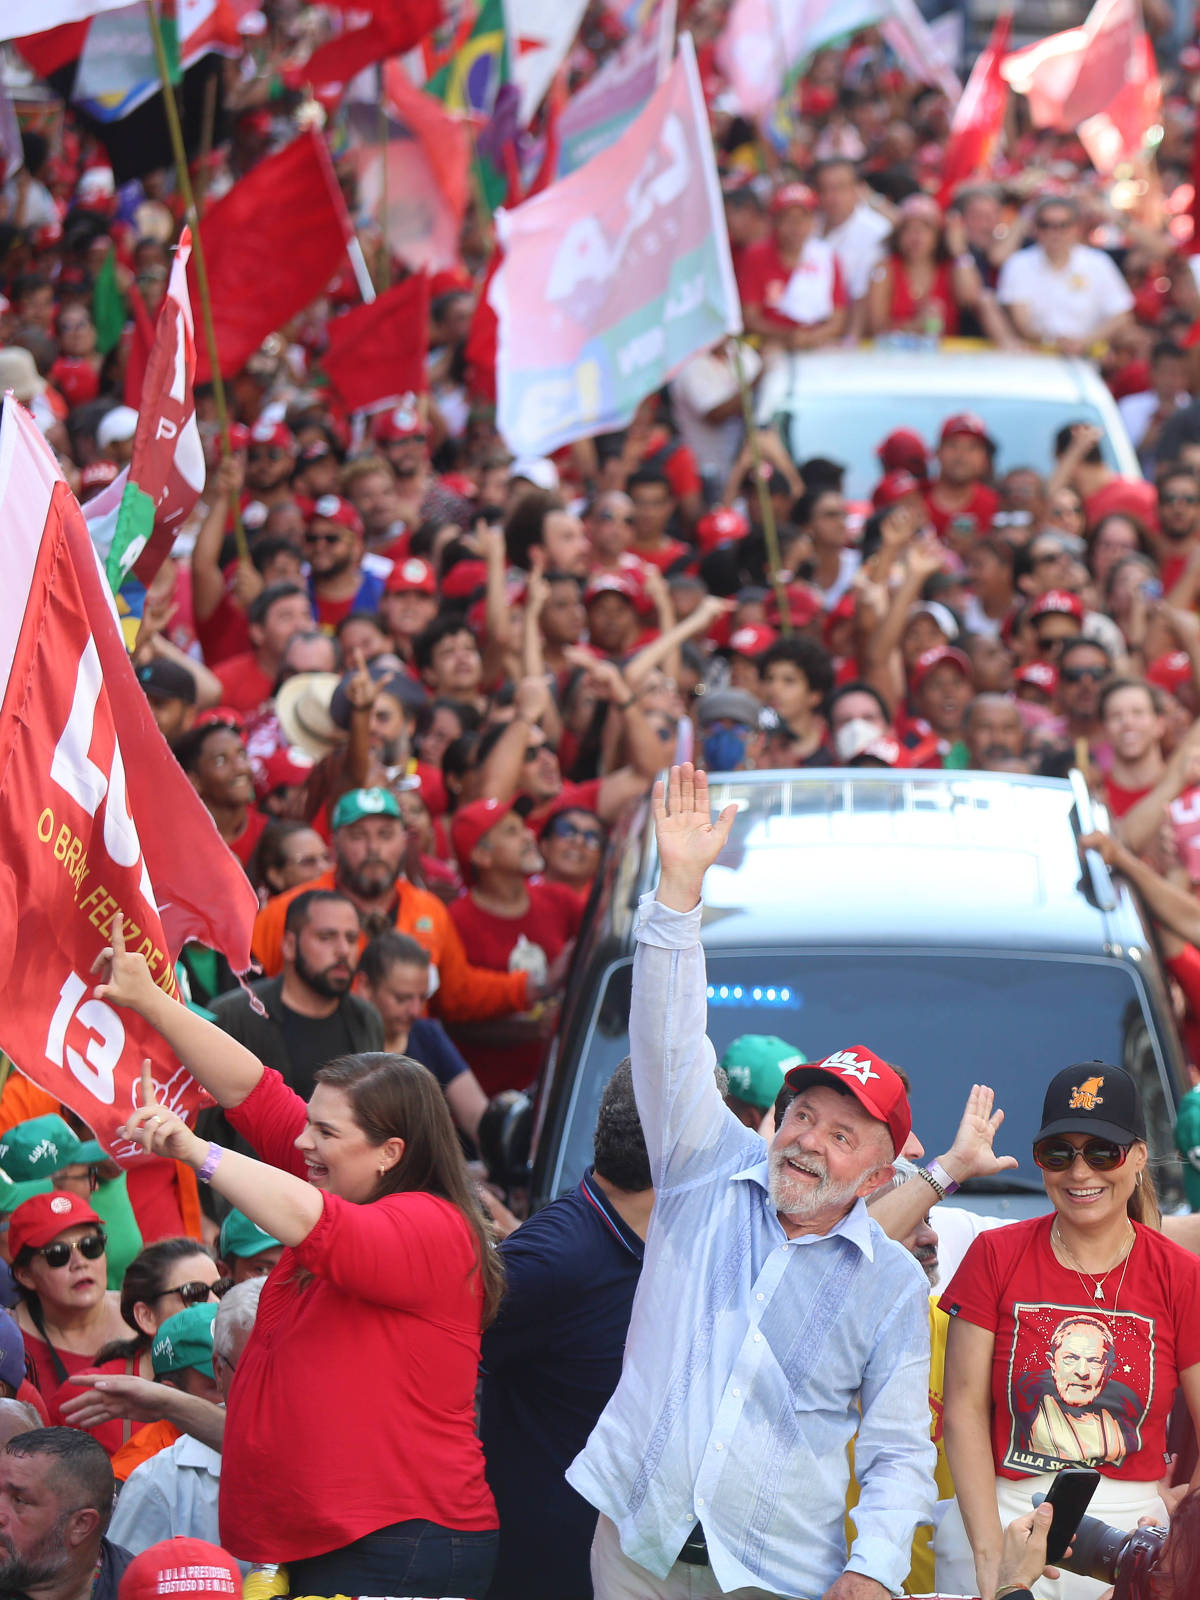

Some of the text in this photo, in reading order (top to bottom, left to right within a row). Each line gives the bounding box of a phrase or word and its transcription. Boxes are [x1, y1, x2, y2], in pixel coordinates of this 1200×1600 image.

[37, 807, 54, 843] O
[45, 971, 126, 1105] 13
[1013, 1452, 1045, 1468] LULA
[158, 1566, 232, 1581] LULA PRESIDENTE
[158, 1580, 197, 1594] GOSTOSO
